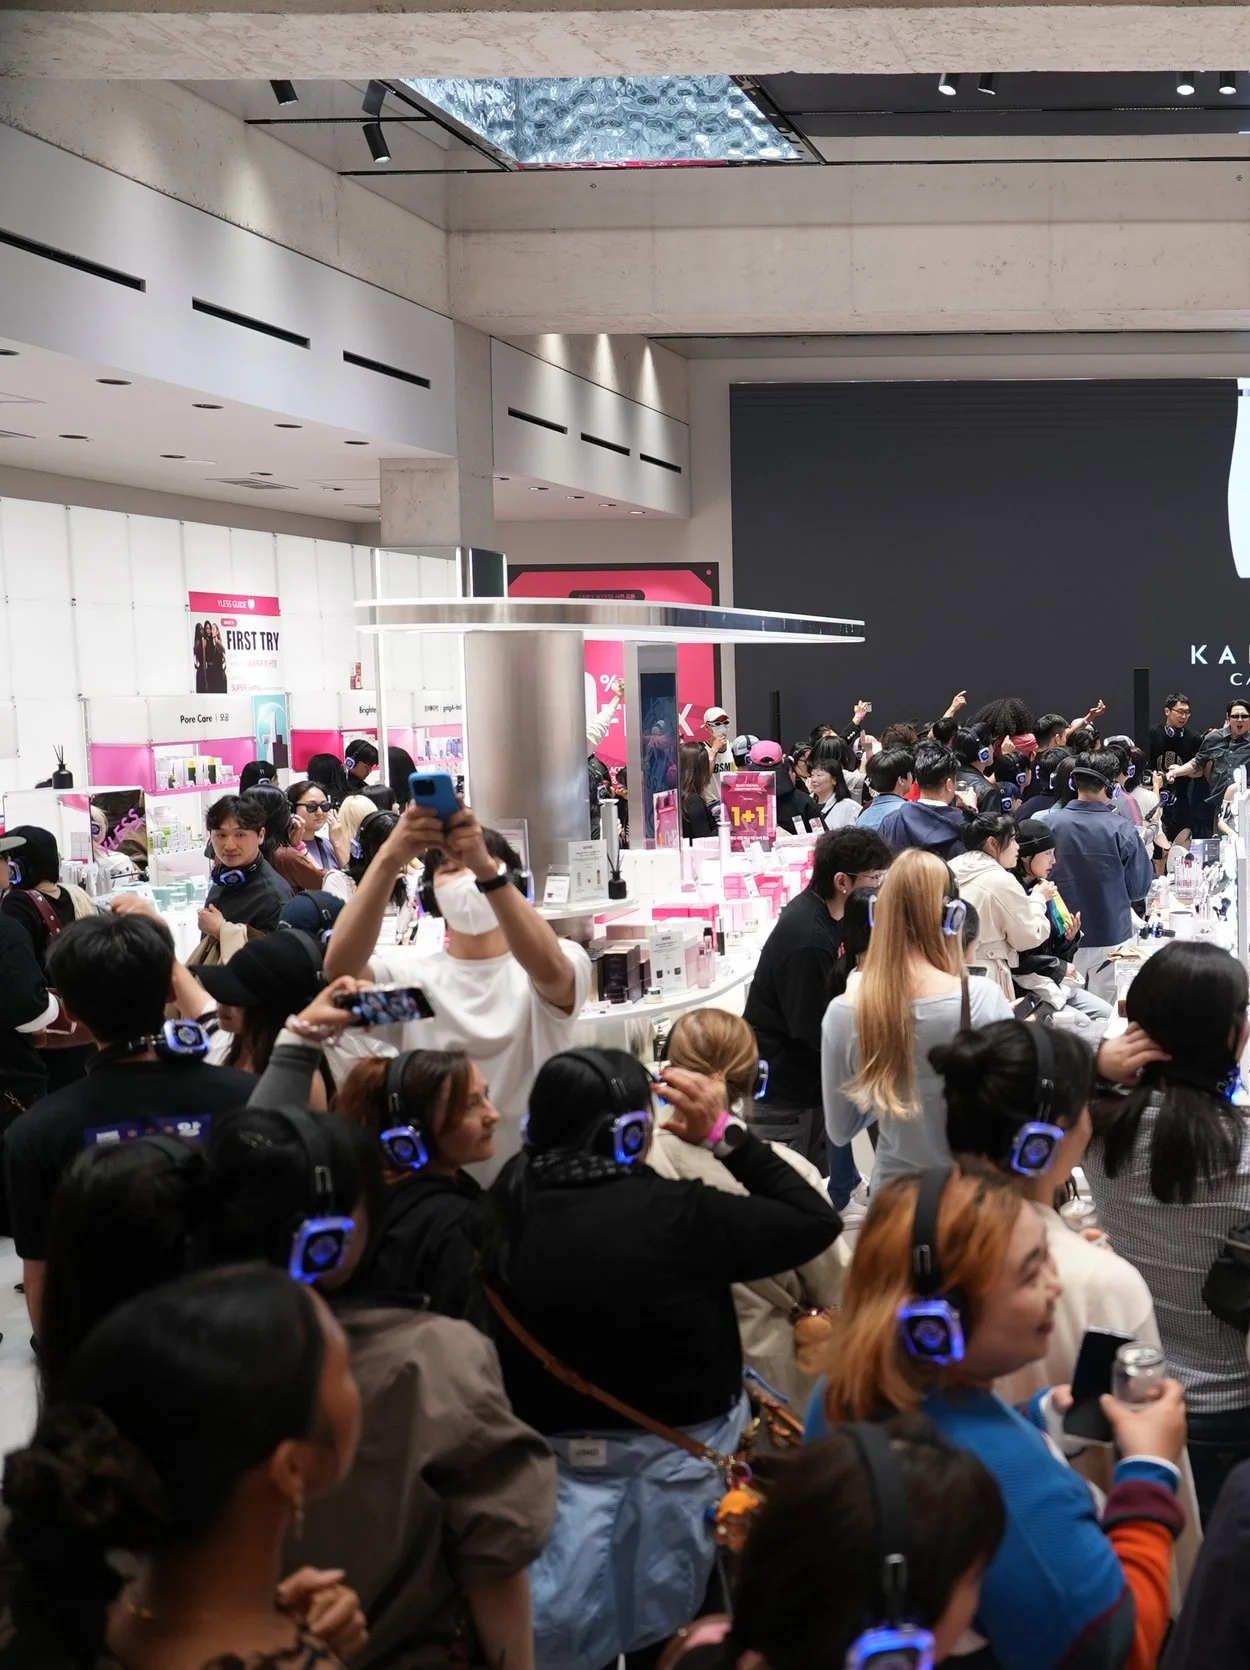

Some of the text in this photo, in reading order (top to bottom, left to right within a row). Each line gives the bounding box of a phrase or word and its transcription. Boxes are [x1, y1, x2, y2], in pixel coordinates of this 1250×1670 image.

[226, 630, 279, 651] FIRST TRY
[180, 713, 213, 724] Pore Care
[731, 806, 765, 827] 1+1
